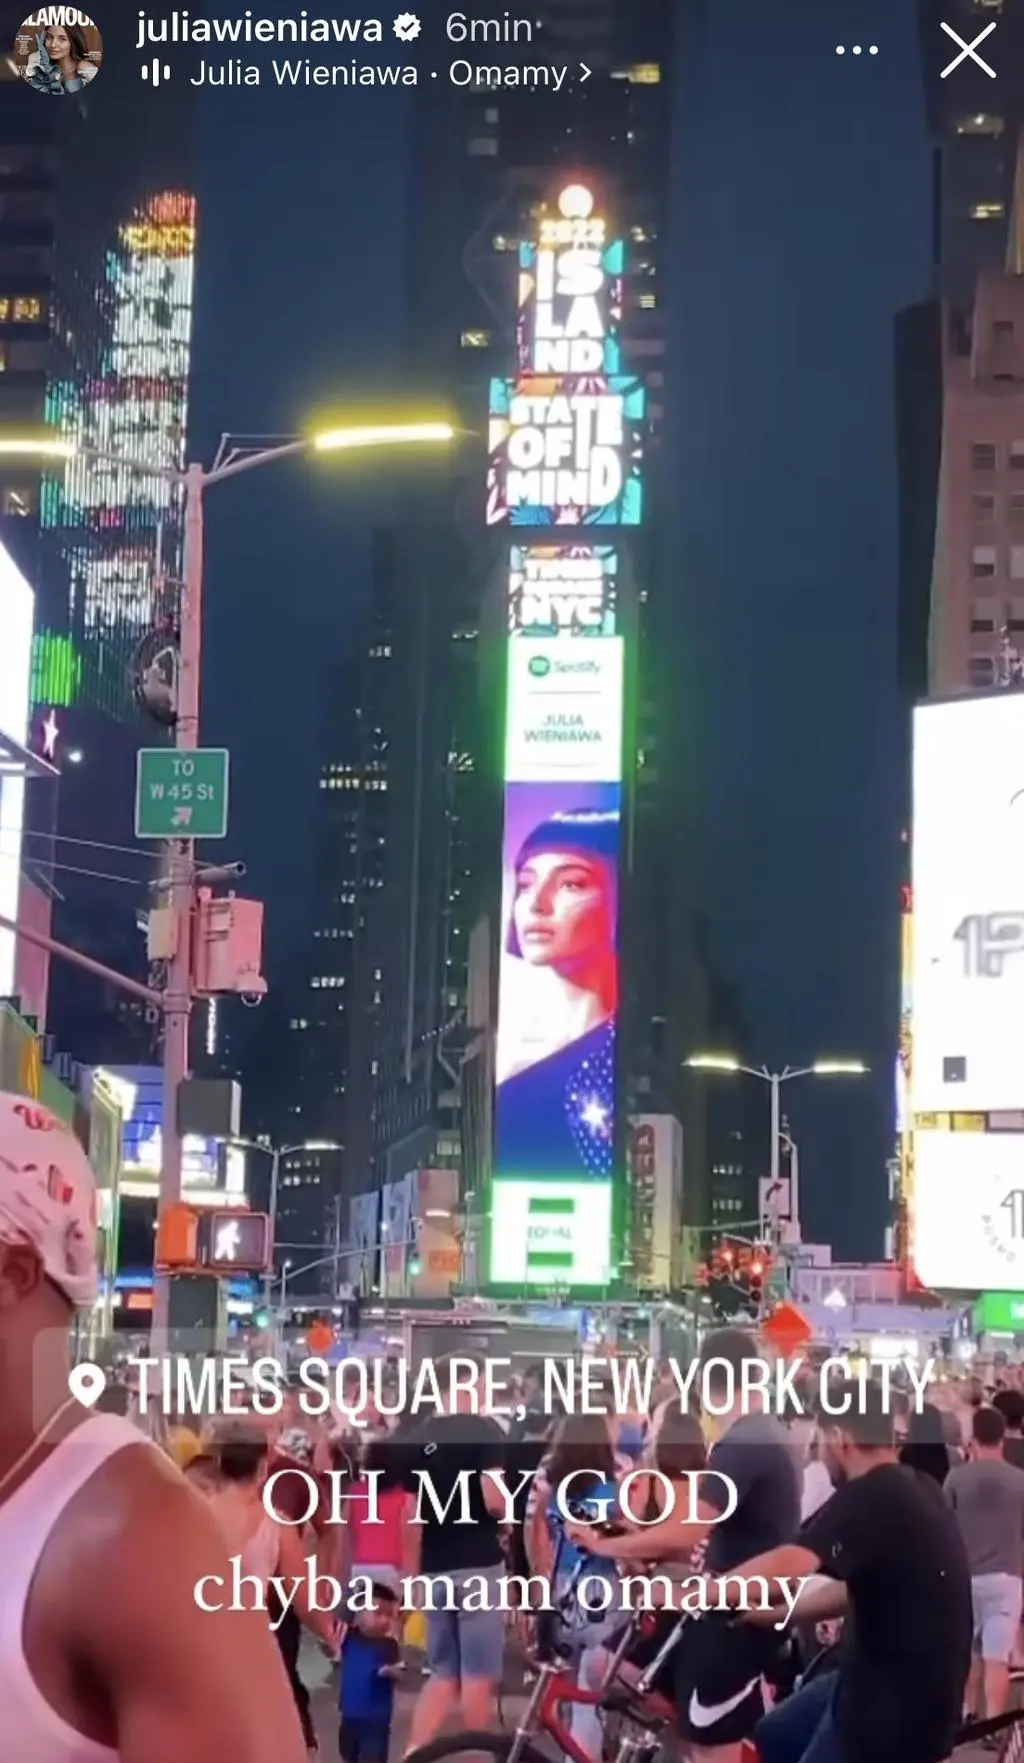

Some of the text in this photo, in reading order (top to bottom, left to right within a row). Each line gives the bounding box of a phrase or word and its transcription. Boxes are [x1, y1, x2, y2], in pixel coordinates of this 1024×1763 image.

[536, 250, 604, 295] IS
[535, 296, 604, 337] LA
[534, 338, 604, 372] ND
[509, 394, 623, 455] STATE
[507, 427, 574, 468] OF
[506, 444, 622, 506] MIND
[521, 596, 603, 626] NYC
[553, 660, 602, 675] Spotify
[523, 730, 603, 743] WIENIAWA
[542, 714, 584, 727] JULIA
[172, 759, 195, 777] TO
[149, 783, 214, 800] W 45 St
